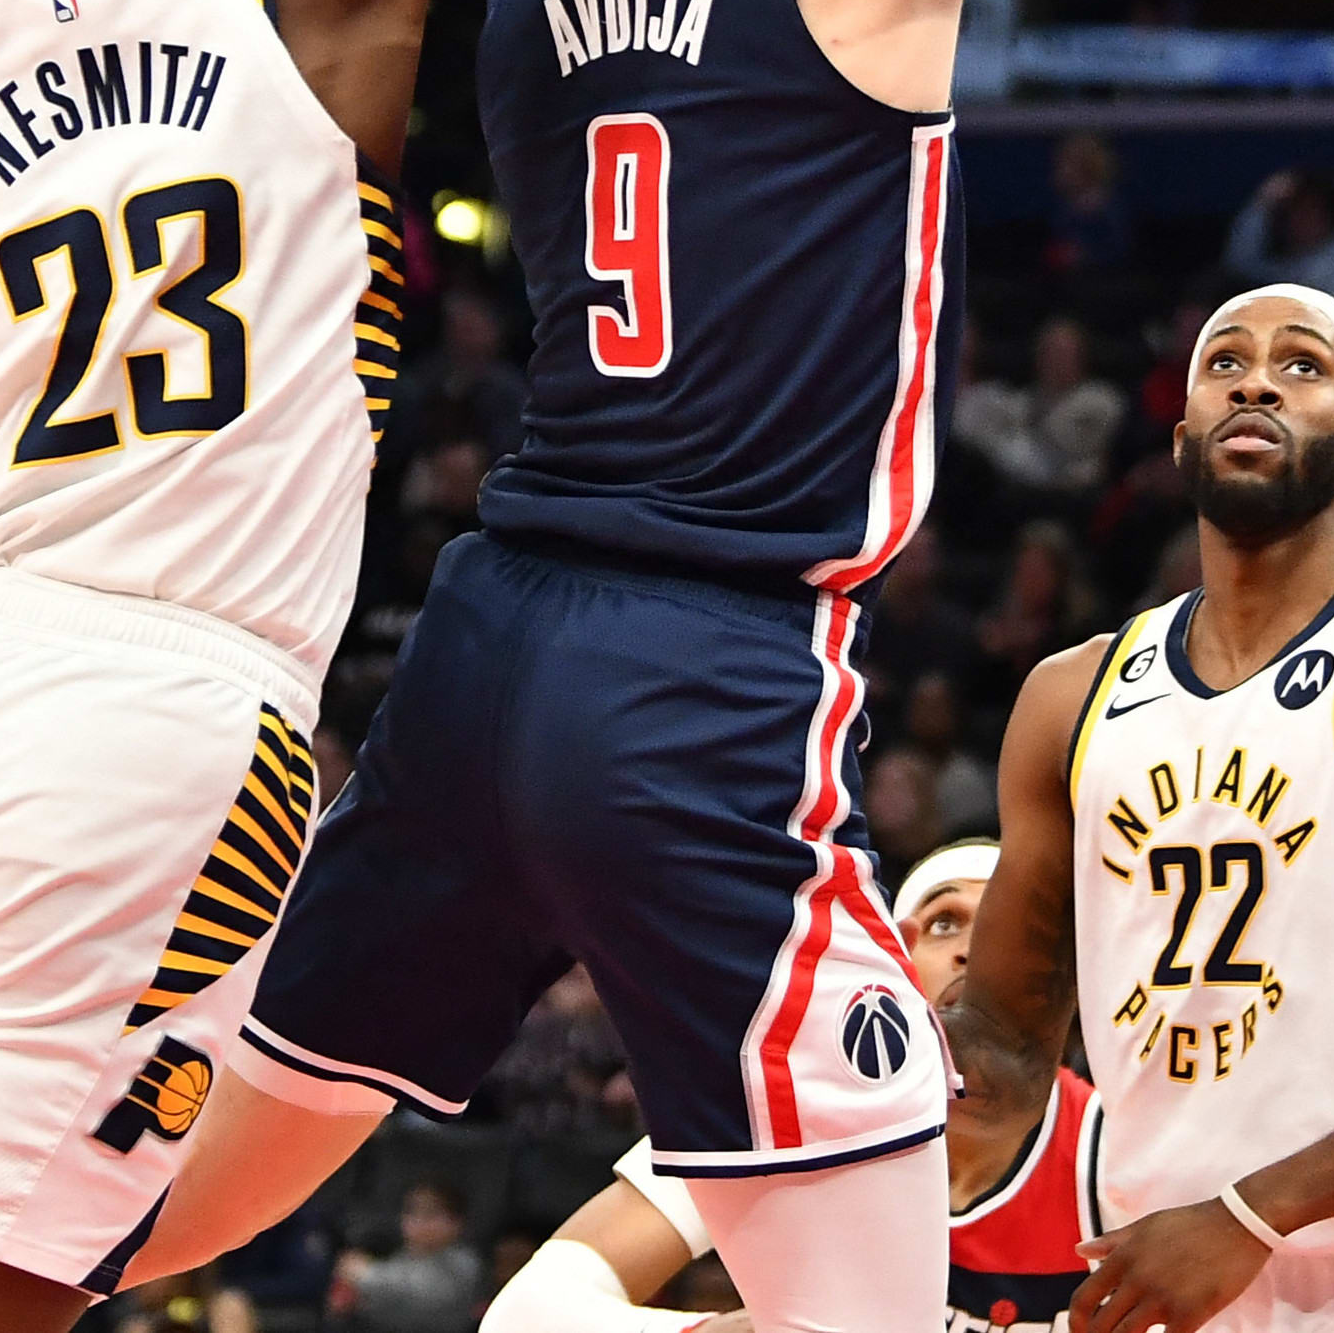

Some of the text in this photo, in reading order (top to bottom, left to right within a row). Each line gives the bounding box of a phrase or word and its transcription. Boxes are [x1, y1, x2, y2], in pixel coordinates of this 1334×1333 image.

[585, 112, 673, 378] 9
[1102, 745, 1318, 885] INDIANA
[1148, 839, 1268, 990] 22
[1112, 966, 1284, 1085] PACERS
